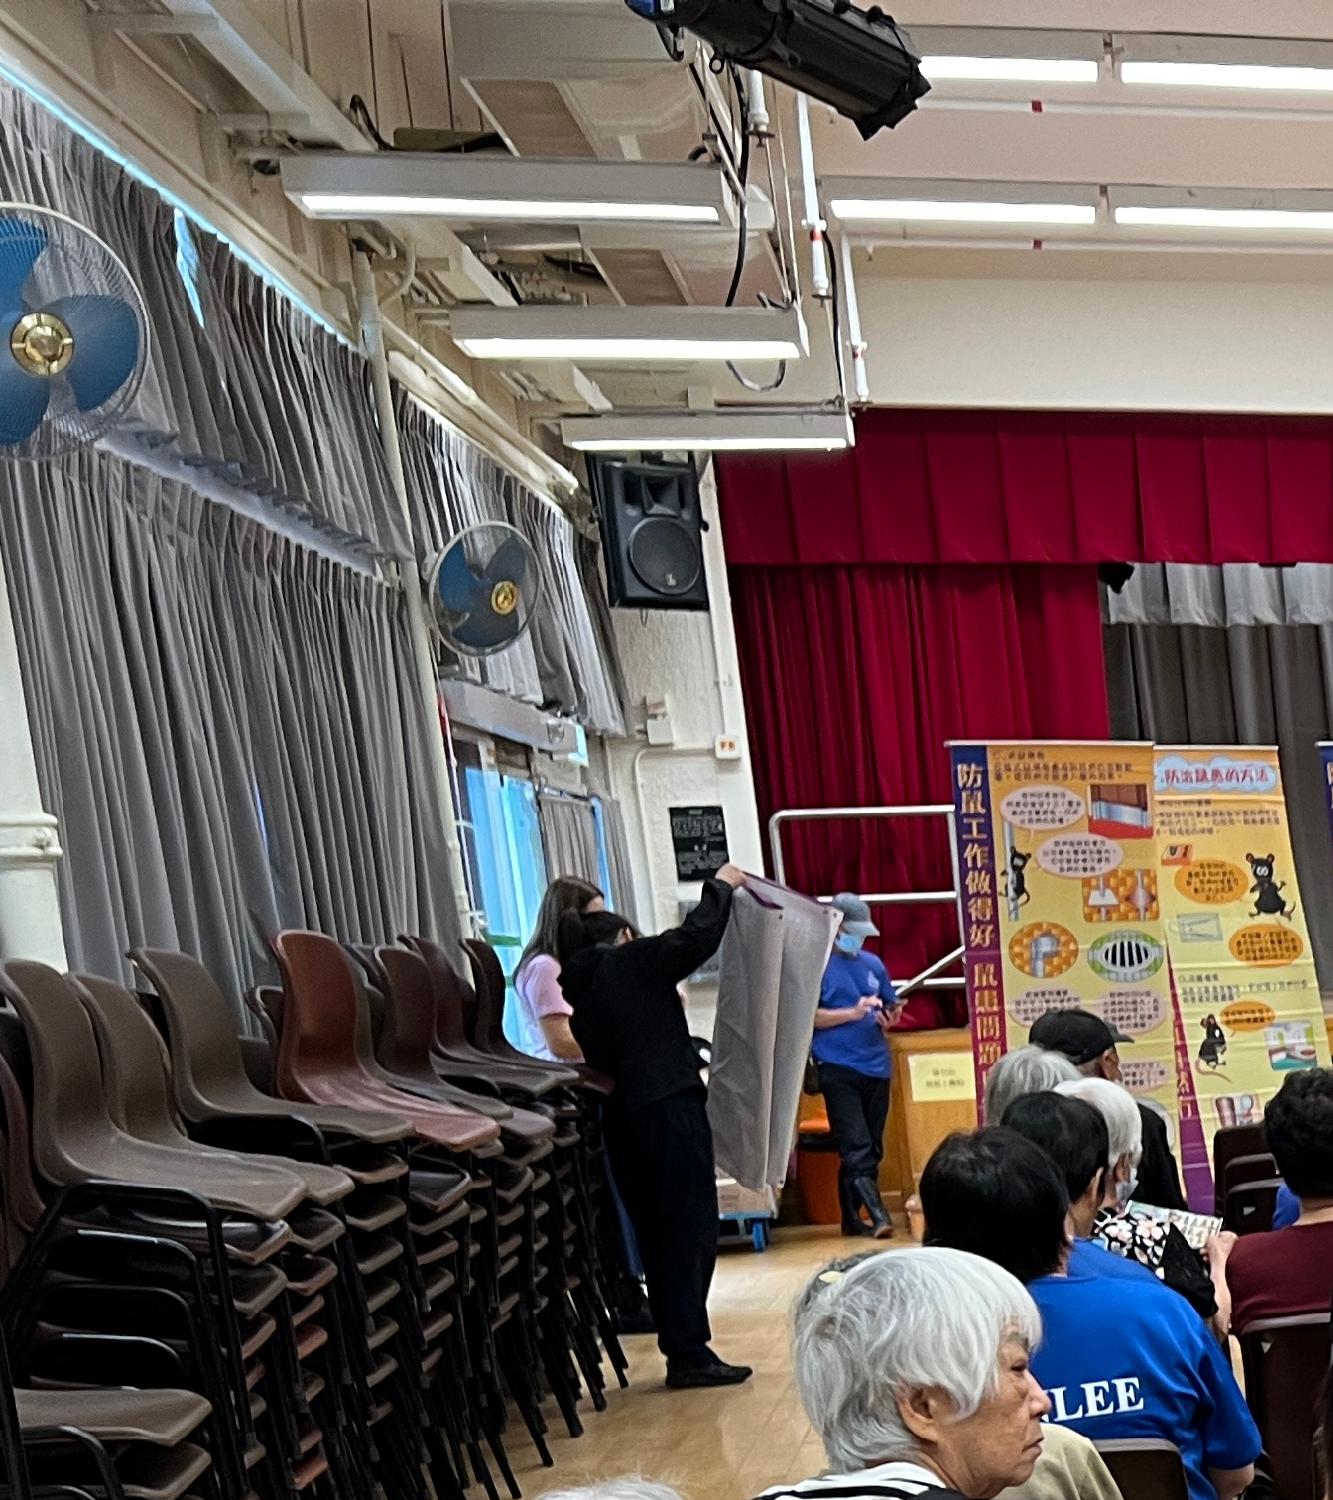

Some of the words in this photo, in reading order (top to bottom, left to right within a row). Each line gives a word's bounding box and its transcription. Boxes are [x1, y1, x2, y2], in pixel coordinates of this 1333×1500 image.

[957, 763, 996, 948] 防鼠工作做得好
[973, 962, 1001, 1080] 鼠患問題
